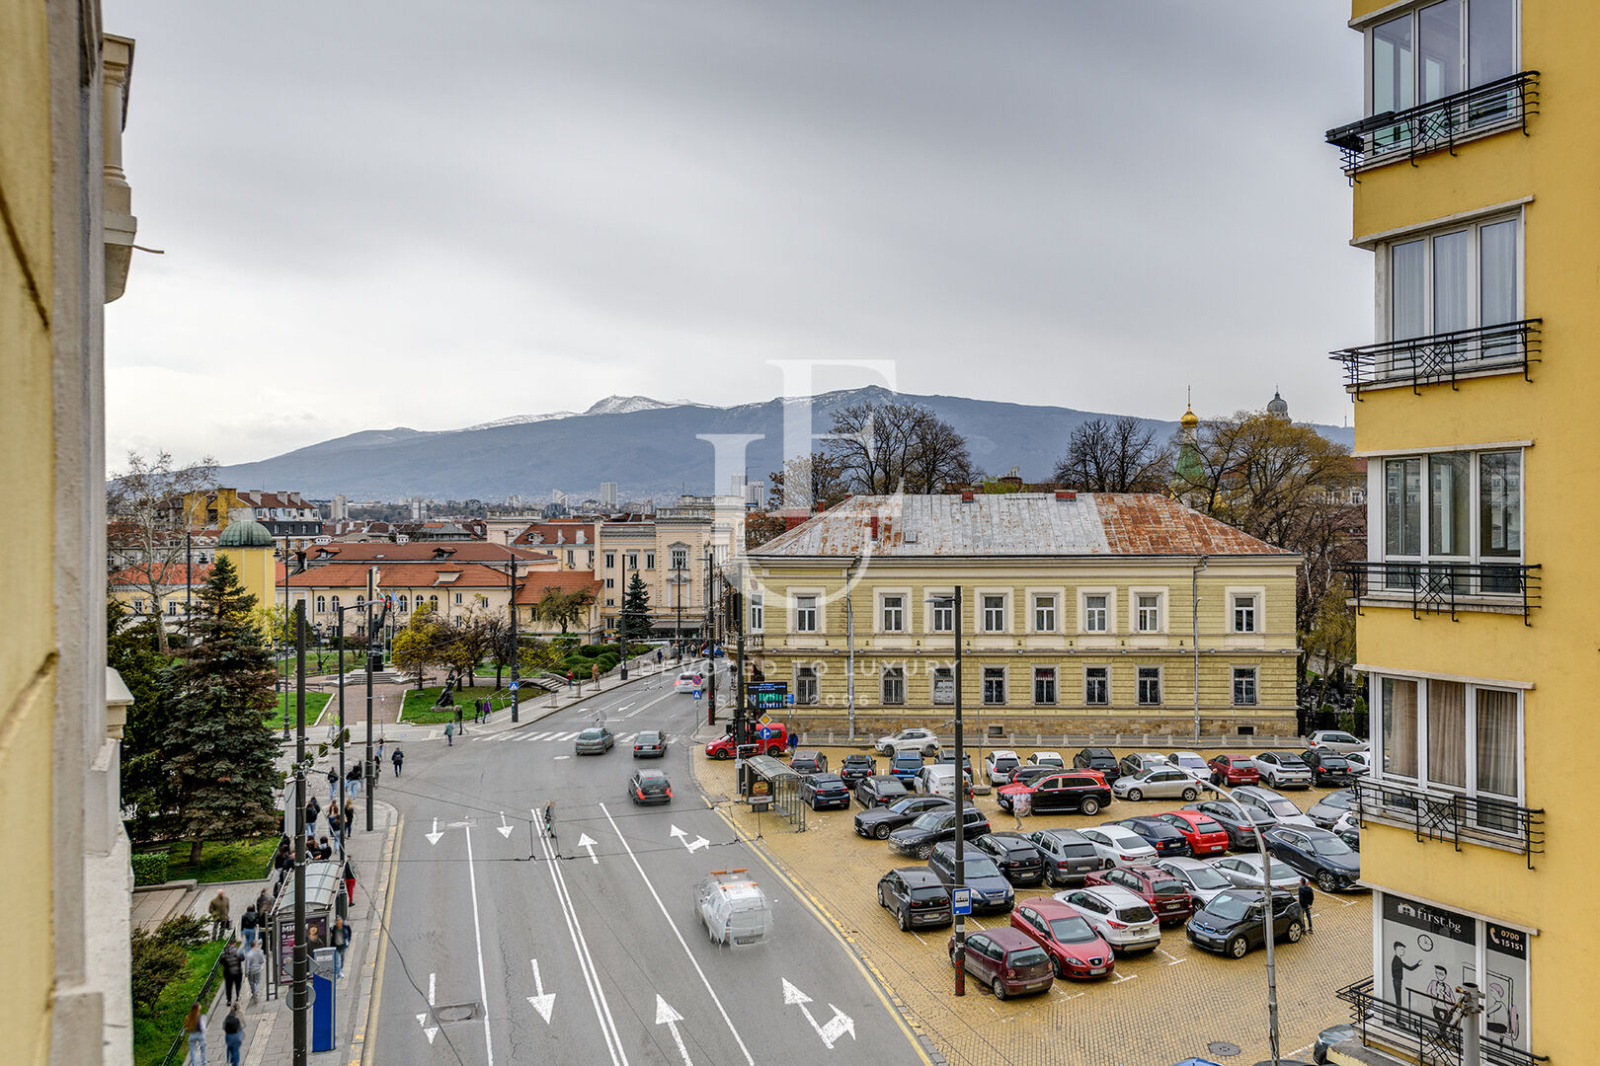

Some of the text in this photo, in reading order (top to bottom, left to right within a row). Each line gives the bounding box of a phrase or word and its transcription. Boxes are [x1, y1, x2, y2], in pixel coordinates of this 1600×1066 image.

[1417, 907, 1462, 933] first.bg
[1501, 930, 1520, 941] 0700
[1501, 939, 1524, 951] 15151
